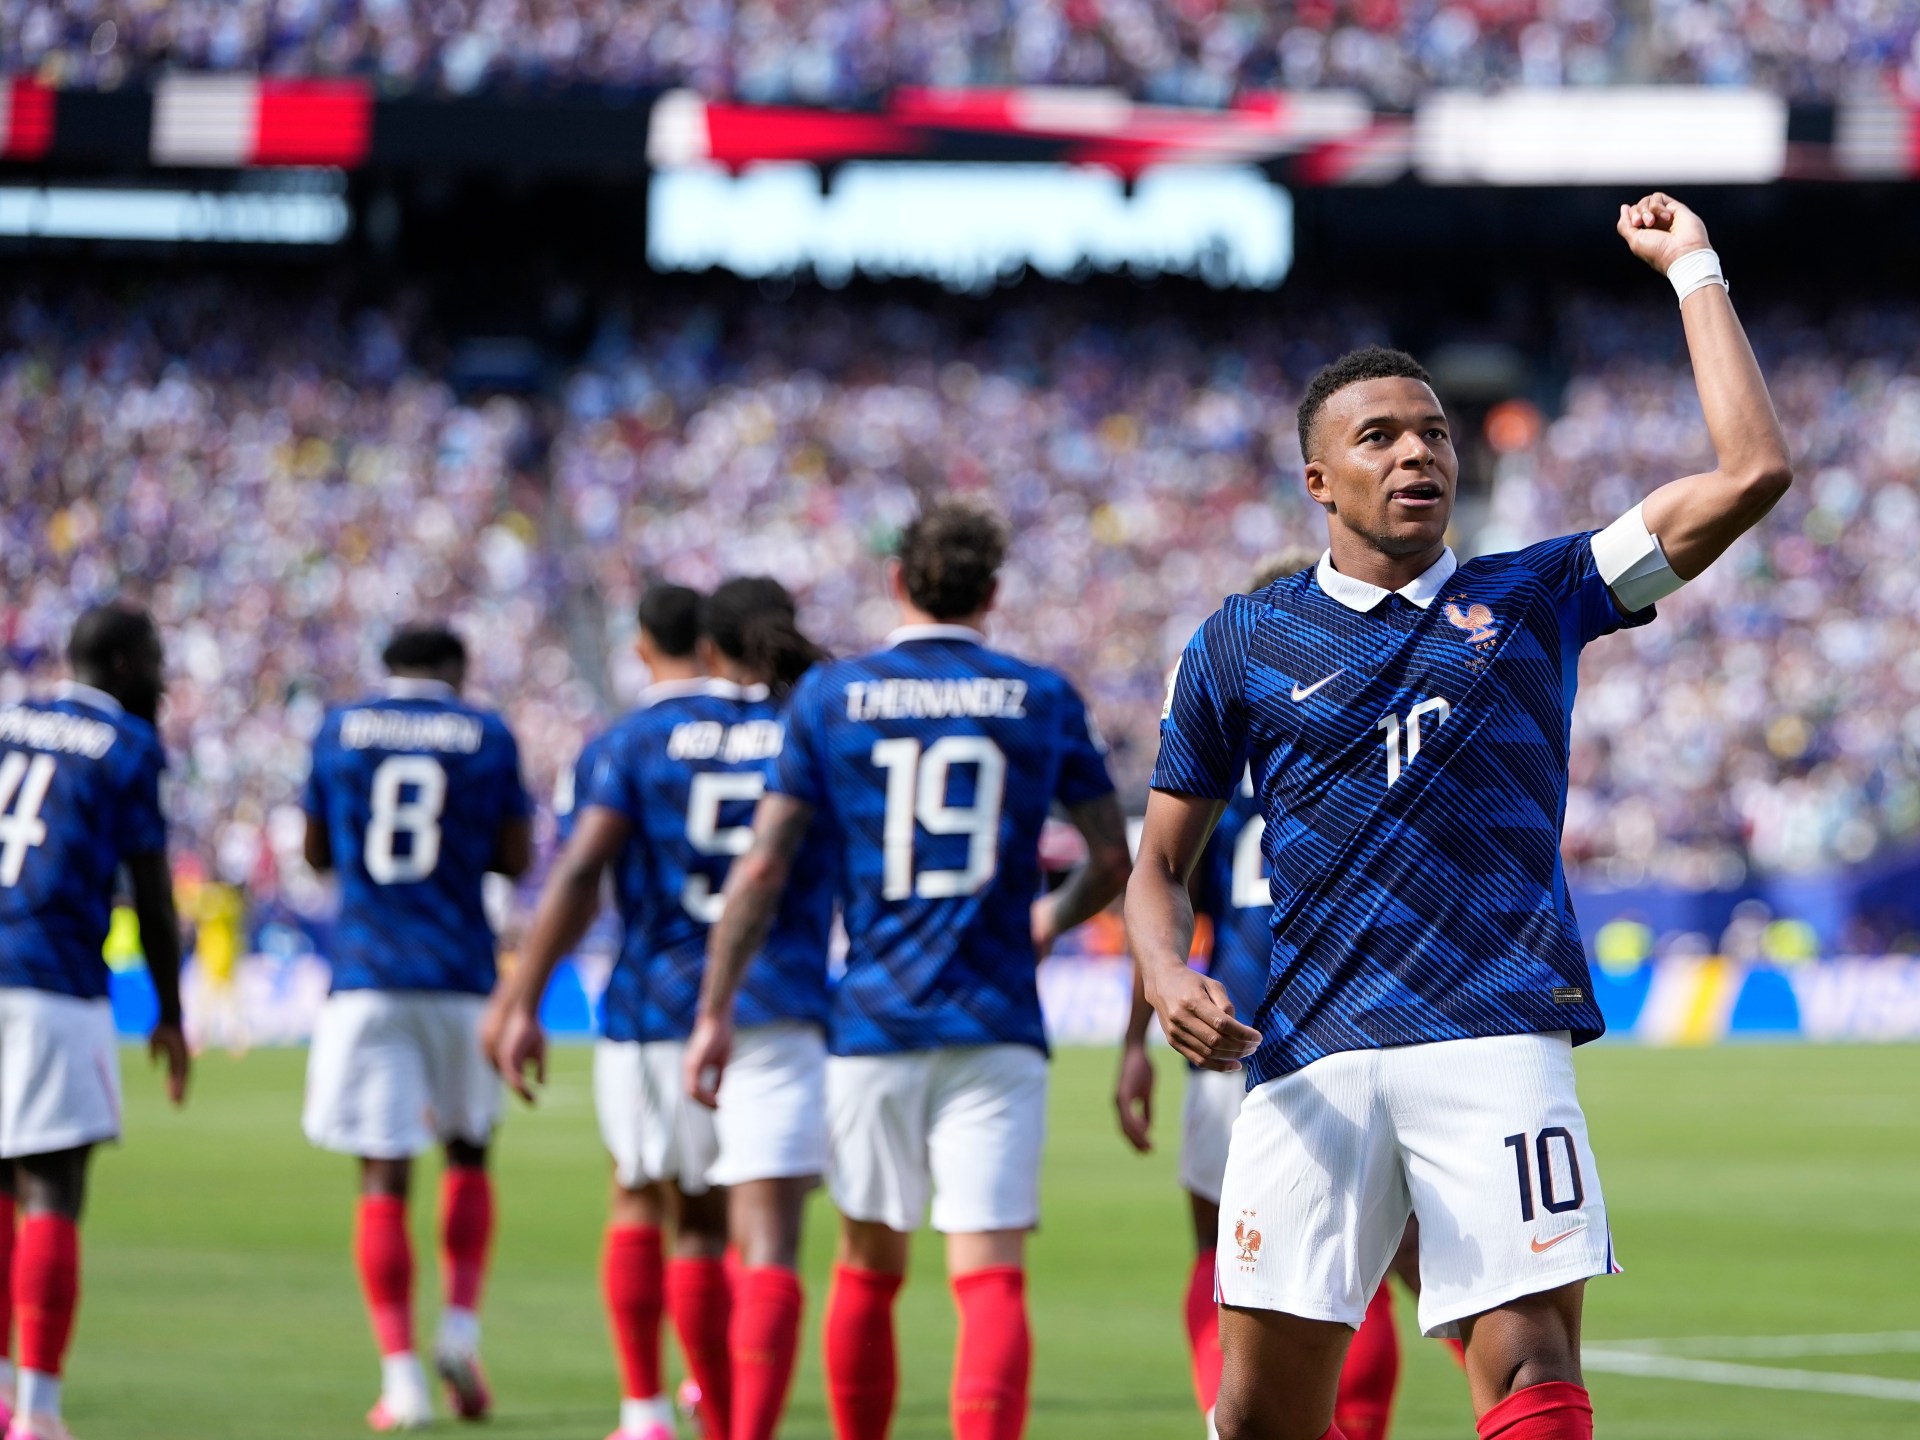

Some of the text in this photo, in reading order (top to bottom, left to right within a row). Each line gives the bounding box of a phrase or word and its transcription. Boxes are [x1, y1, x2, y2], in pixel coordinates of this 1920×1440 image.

[364, 755, 446, 885] 8
[682, 772, 767, 923] 5
[871, 735, 1006, 901] 19
[1504, 1126, 1584, 1222] 10
